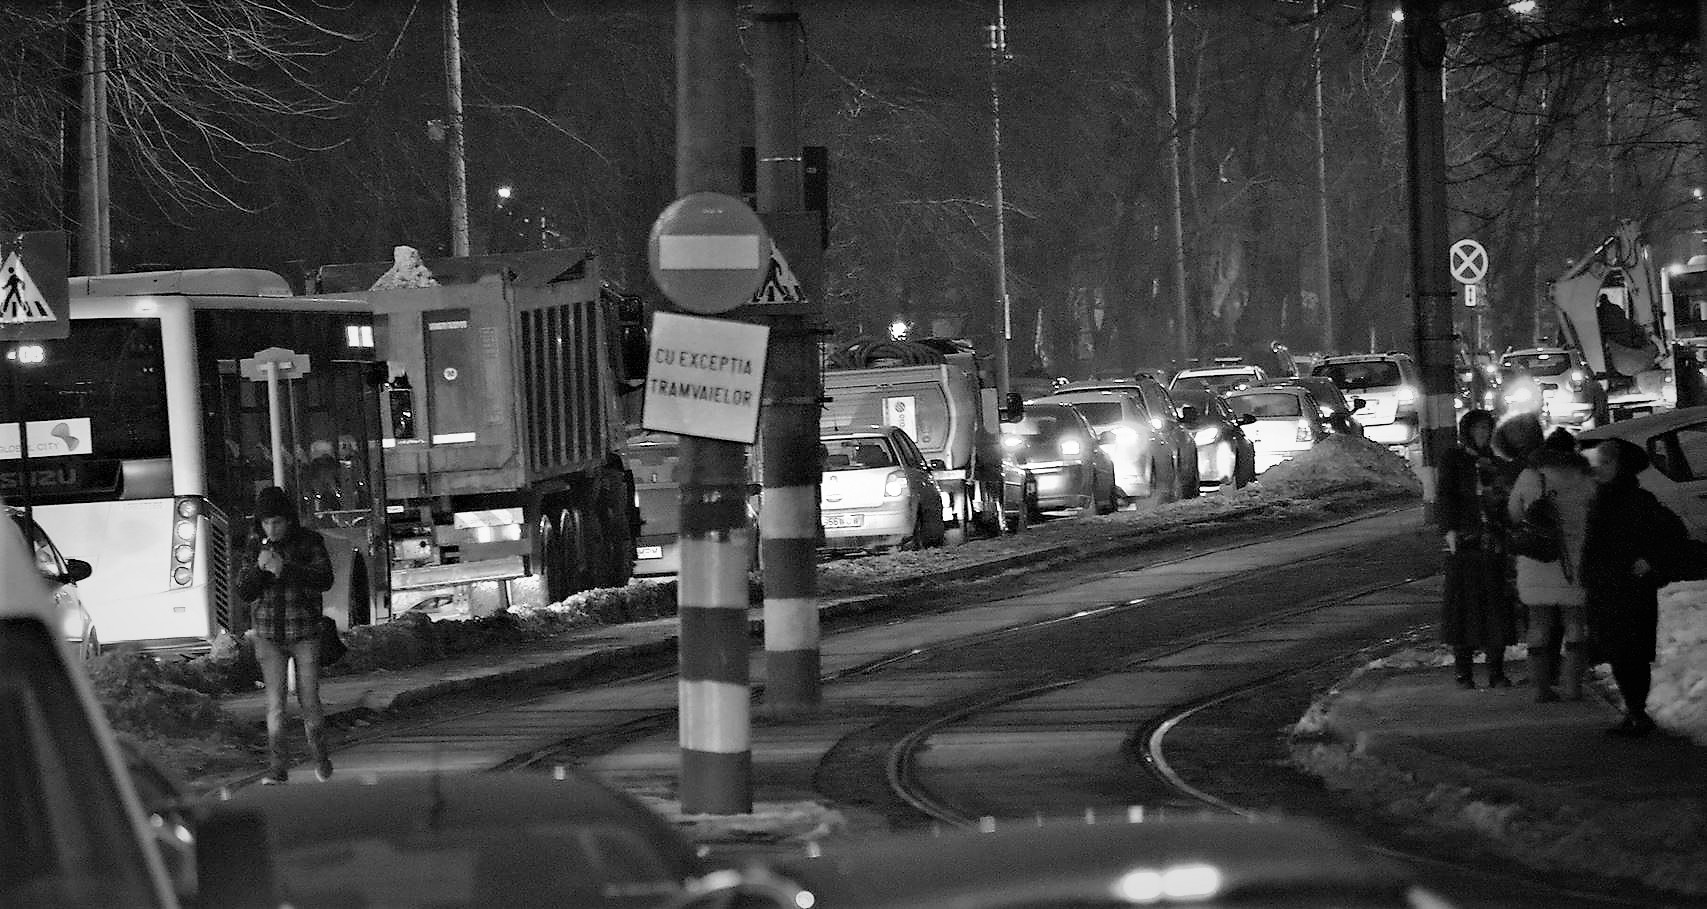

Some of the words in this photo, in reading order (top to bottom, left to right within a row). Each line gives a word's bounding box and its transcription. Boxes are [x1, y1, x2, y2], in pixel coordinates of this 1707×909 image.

[655, 348, 675, 365] CU
[679, 351, 752, 375] EXCEPTIA
[651, 379, 752, 407] TRAMVAIELOR
